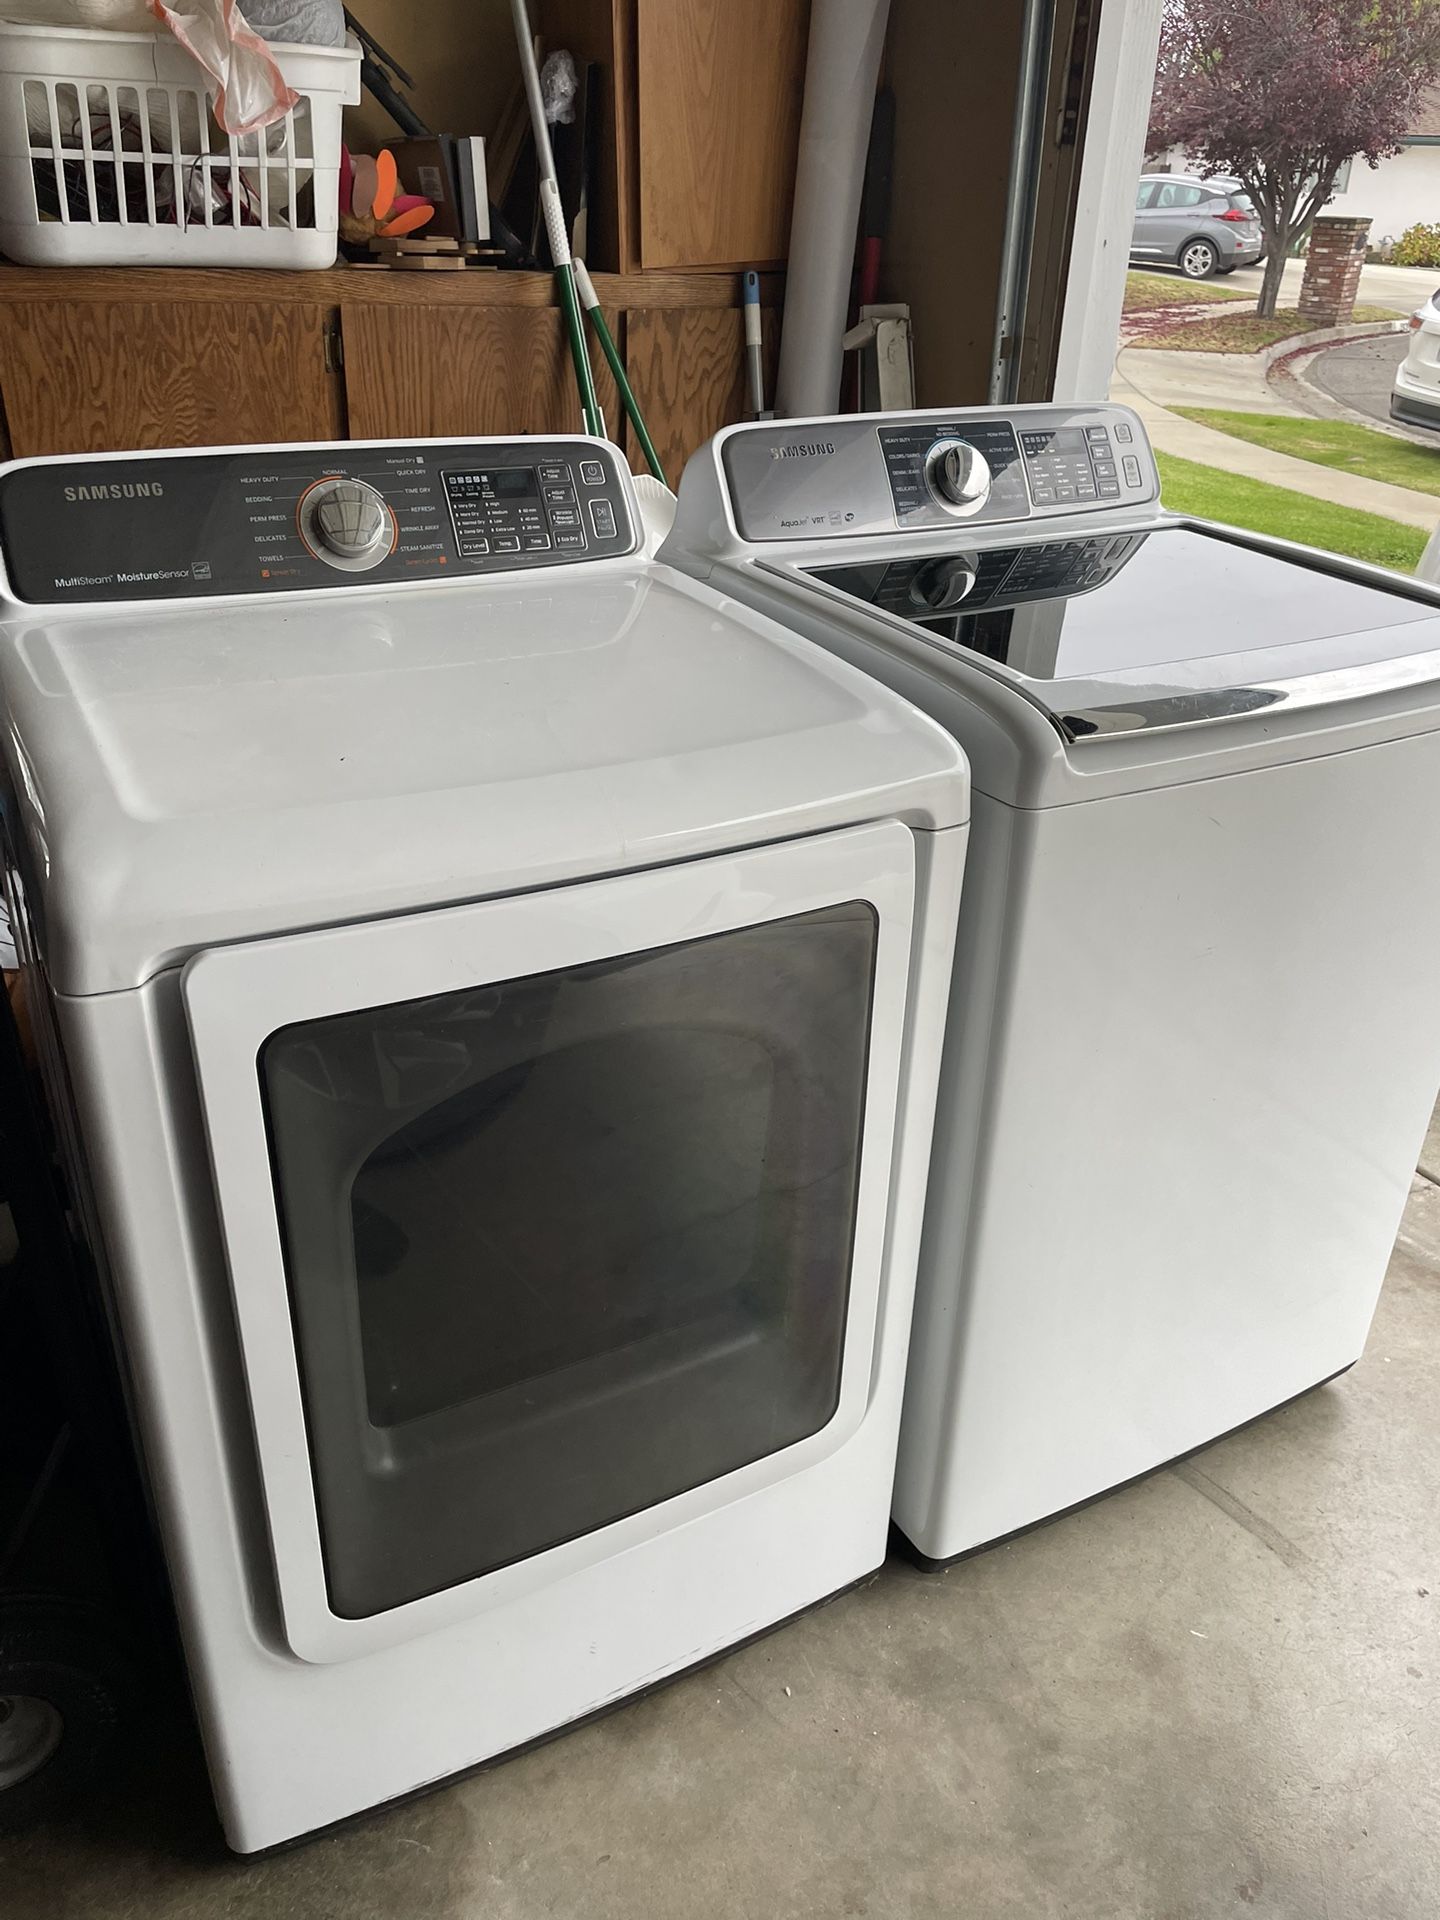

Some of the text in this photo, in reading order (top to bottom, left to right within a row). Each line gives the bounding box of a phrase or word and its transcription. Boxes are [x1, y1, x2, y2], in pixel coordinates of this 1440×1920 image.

[770, 443, 836, 460] SAMSUNG
[64, 482, 164, 502] SAMSUNG
[812, 516, 824, 524] VRT
[116, 570, 190, 583] MoistureSensor
